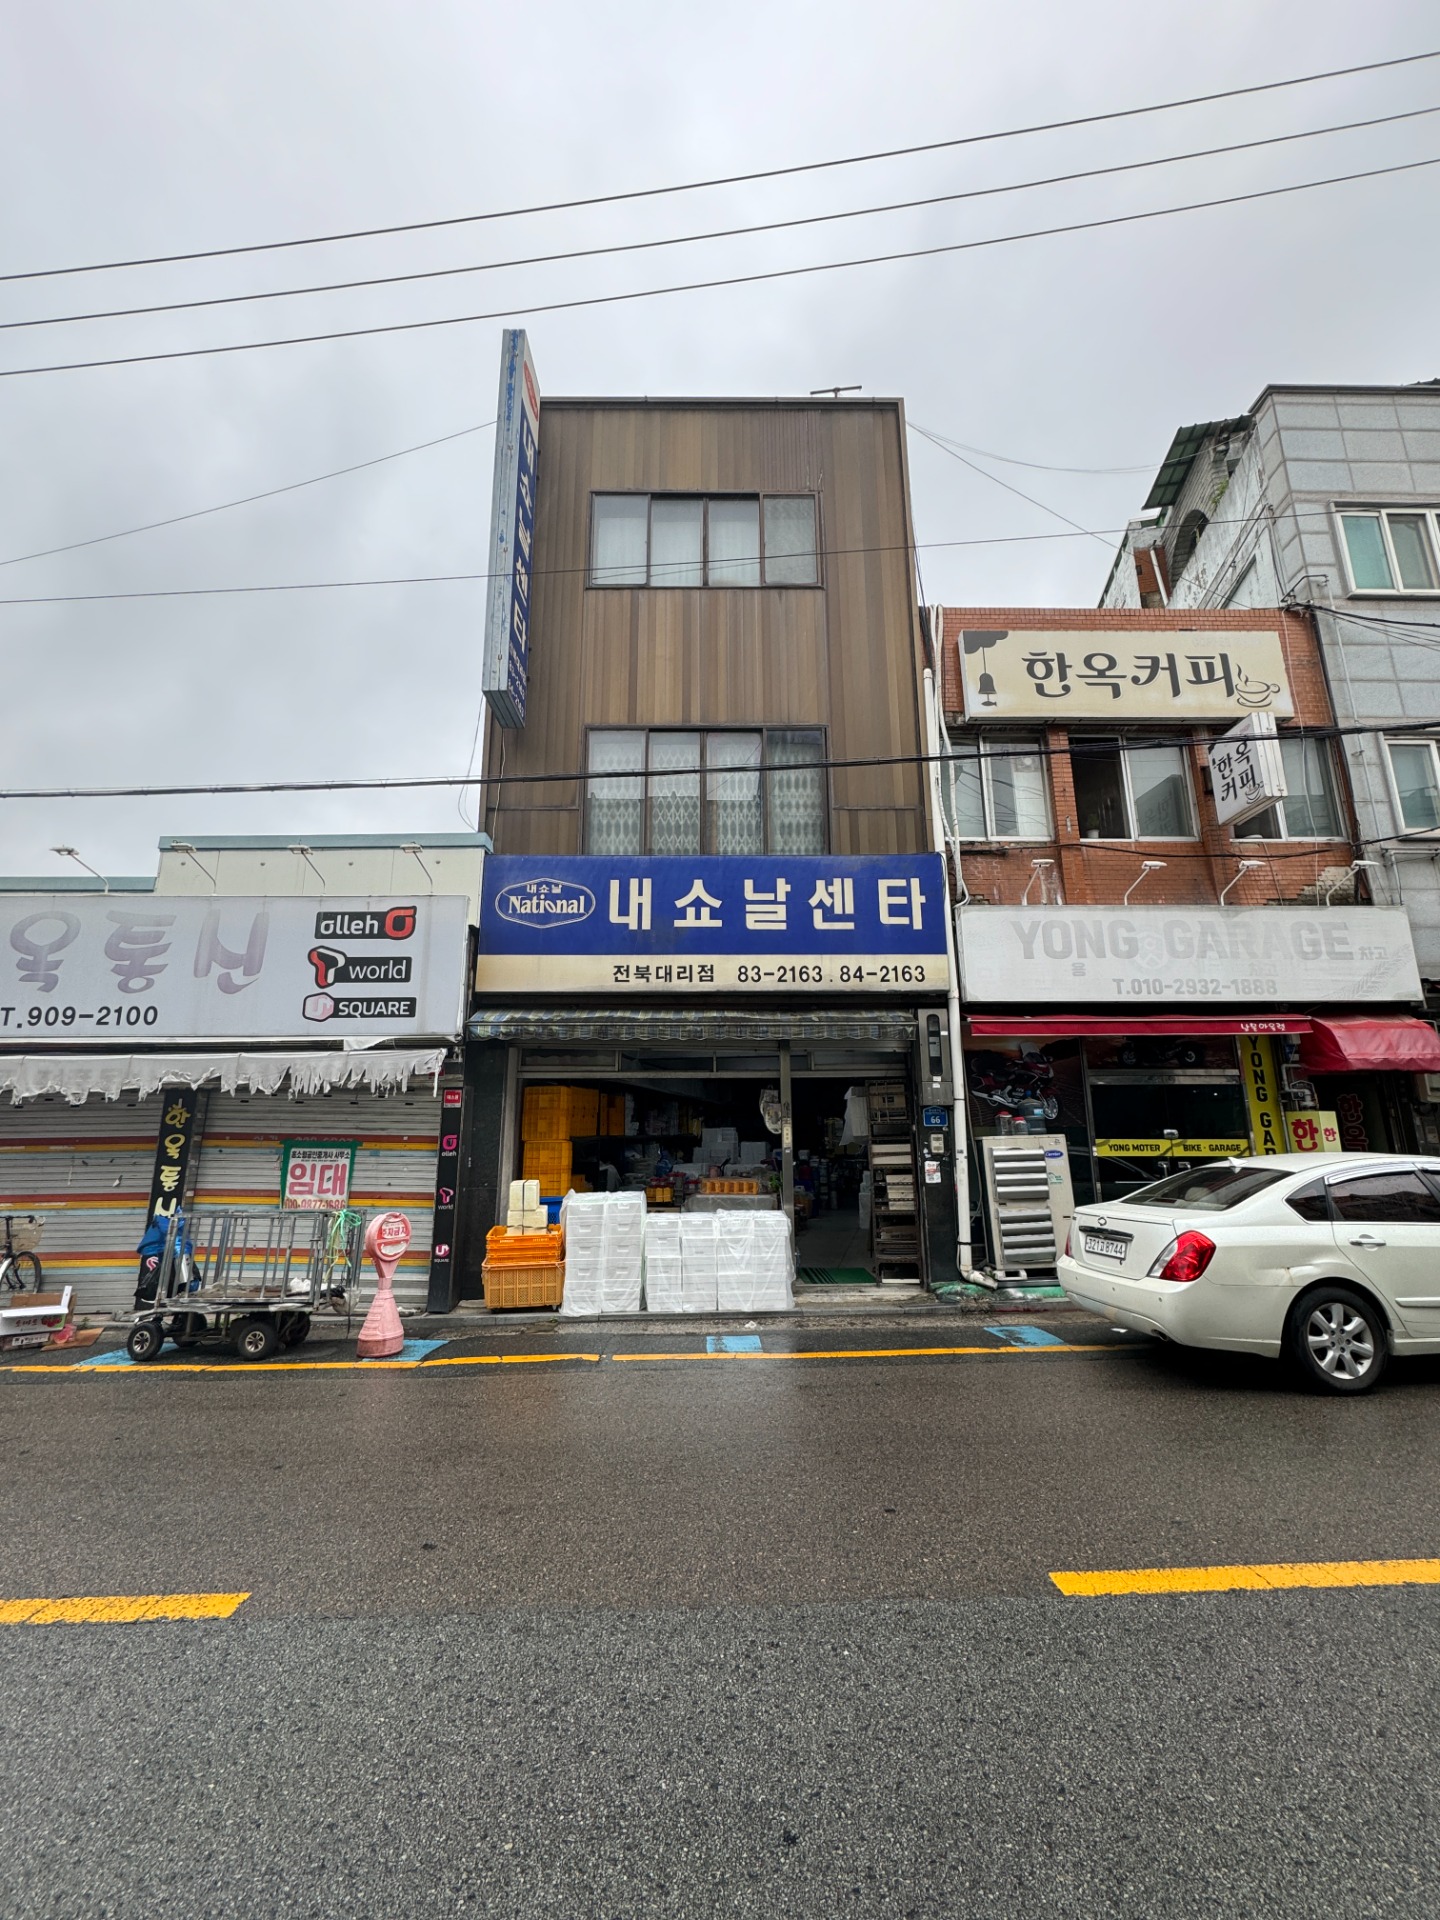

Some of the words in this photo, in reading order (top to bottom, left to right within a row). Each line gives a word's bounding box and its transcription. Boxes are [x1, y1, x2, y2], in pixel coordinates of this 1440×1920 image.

[1021, 651, 1235, 700] 한옥커피
[508, 893, 585, 914] National
[320, 915, 379, 935] olleh
[1010, 919, 1139, 960] YONG
[1164, 919, 1354, 961] GARAGE
[349, 959, 406, 979] world
[612, 964, 715, 983] 전북대리점
[1112, 978, 1278, 996] T.010-2932-1888
[1, 1005, 159, 1029] T.909-2100
[338, 1001, 411, 1018] SQUARE
[1248, 1034, 1268, 1102] YONG
[930, 1115, 941, 1124] 66
[1291, 1119, 1319, 1152] 한
[1323, 1128, 1337, 1142] 한
[1108, 1144, 1130, 1152] YONG
[1132, 1144, 1161, 1152] MOTER
[1183, 1144, 1202, 1152] BIKE
[1209, 1144, 1242, 1152] GARAGE
[288, 1163, 347, 1195] 임대
